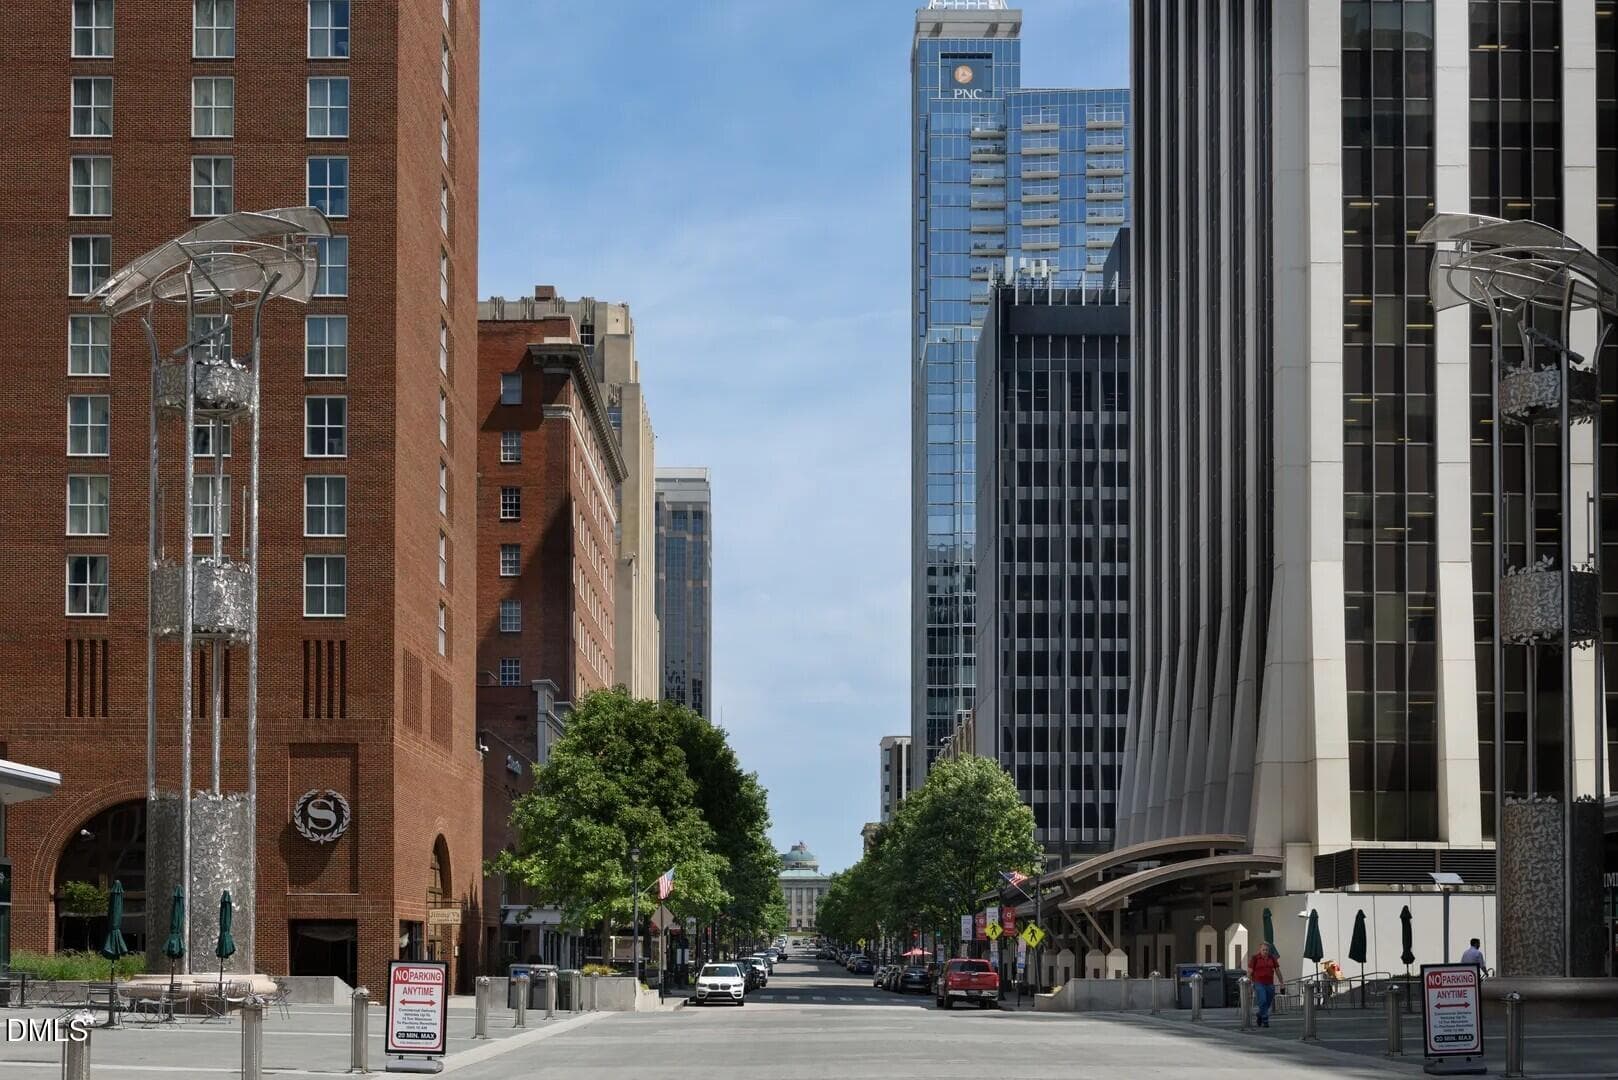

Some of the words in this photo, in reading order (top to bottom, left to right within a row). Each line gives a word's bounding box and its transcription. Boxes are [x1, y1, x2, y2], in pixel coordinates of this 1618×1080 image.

[953, 88, 983, 99] PNC
[395, 970, 409, 981] NO
[409, 971, 441, 982] PARKING
[1428, 975, 1442, 986] NO
[1442, 974, 1473, 984] PARKING
[402, 986, 434, 996] ANYTIME
[1437, 990, 1467, 999] ANYTIME
